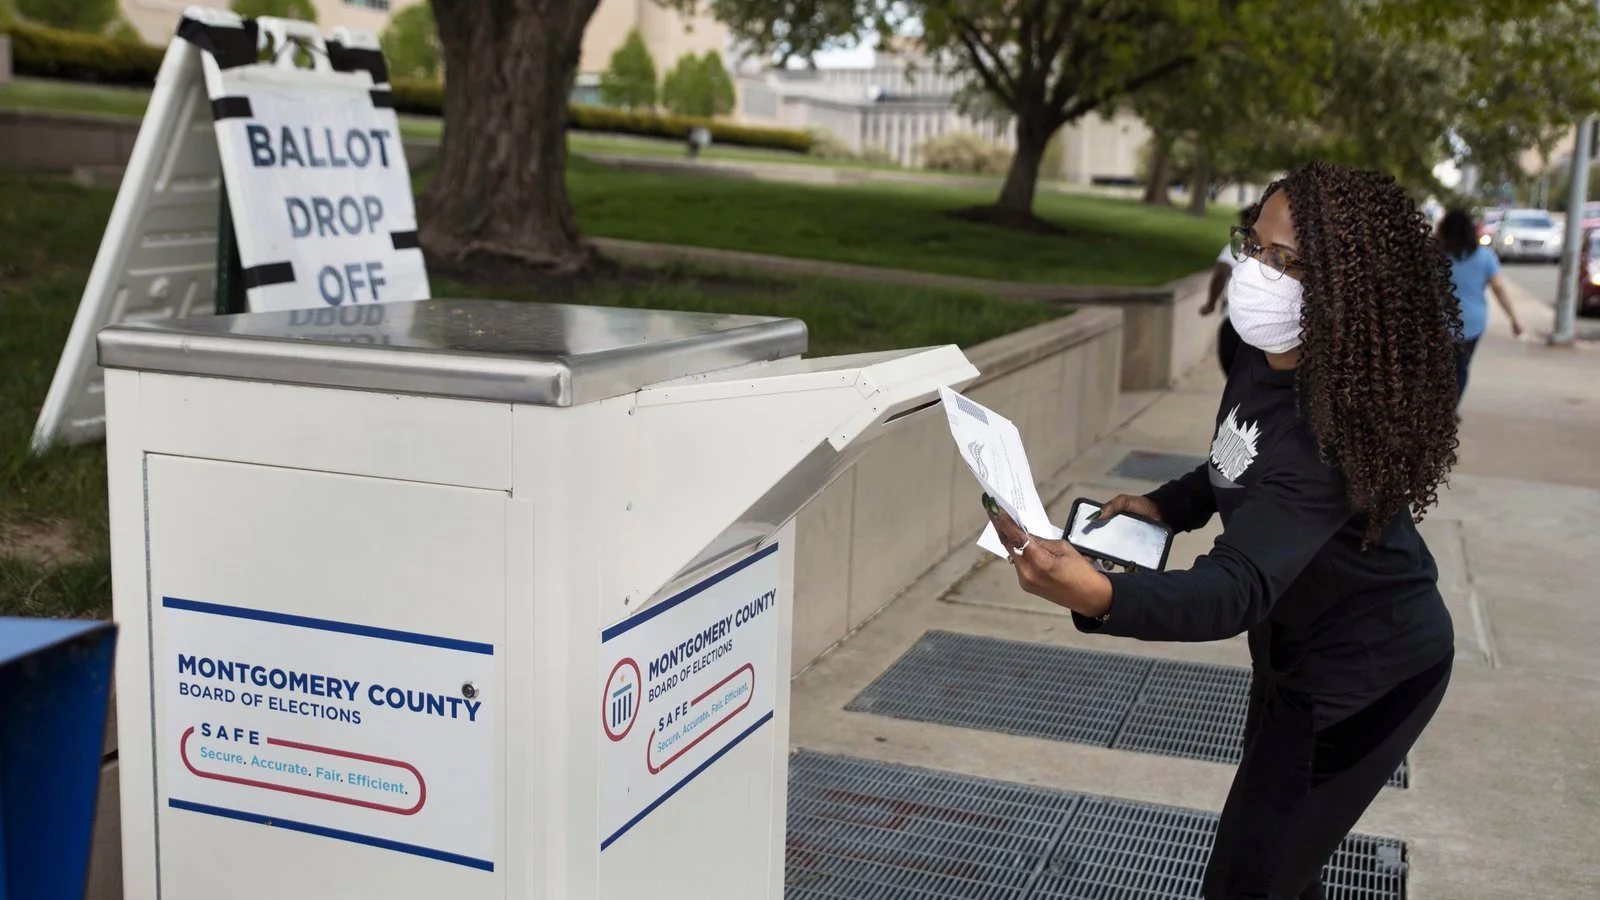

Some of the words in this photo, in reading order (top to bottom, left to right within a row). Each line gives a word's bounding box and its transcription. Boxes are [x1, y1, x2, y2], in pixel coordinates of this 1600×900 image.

[246, 124, 391, 168] BALLOT
[285, 196, 384, 238] DROP
[318, 262, 386, 306] OFF
[649, 614, 733, 682] MONTGOMERY
[735, 588, 777, 628] COUNTY
[178, 654, 360, 701] MONTGOMERY
[368, 684, 482, 722] COUNTY
[648, 674, 678, 703] BOARD
[680, 665, 691, 683] OF
[693, 639, 733, 675] ELECTIONS
[179, 682, 235, 703] BOARD
[241, 692, 263, 707] OF
[269, 697, 361, 724] ELECTIONS
[657, 731, 681, 754] Secure.
[682, 711, 710, 735] Accurate.
[711, 699, 724, 714] Fair.
[725, 682, 749, 704] Efficient.
[658, 701, 688, 732] SAFE
[201, 723, 260, 745] SAFE
[200, 747, 246, 765] Secure.
[250, 755, 312, 776] Accurate.
[316, 767, 344, 782] Fair.
[348, 773, 408, 795] Efficient.
